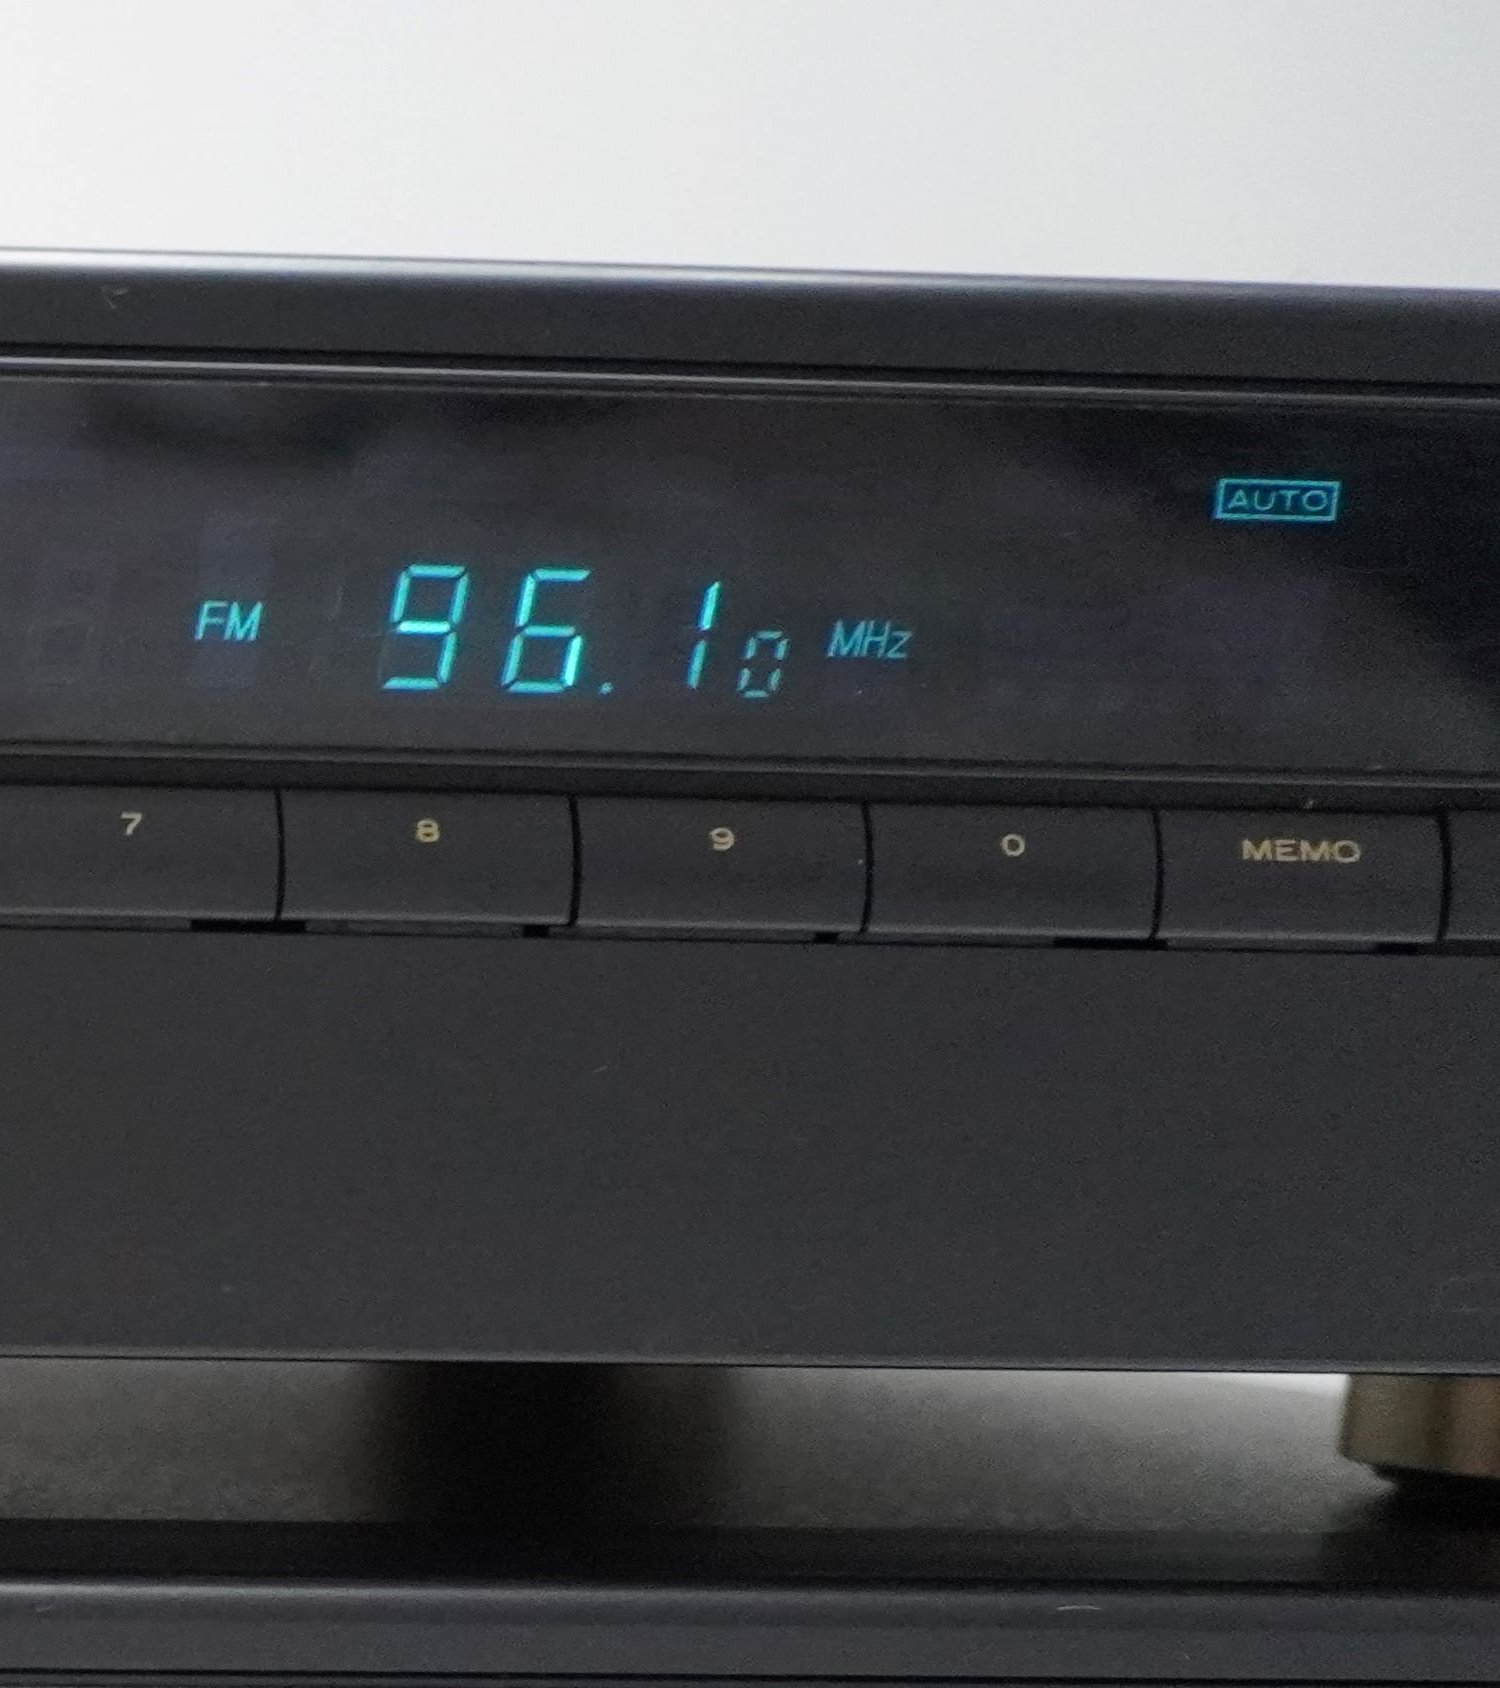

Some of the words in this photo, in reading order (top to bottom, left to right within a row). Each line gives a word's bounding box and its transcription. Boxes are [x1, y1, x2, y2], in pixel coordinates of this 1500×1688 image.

[1227, 487, 1328, 514] AUTO
[194, 601, 263, 642] FM
[826, 620, 912, 659] MHz
[121, 812, 143, 836] 7
[415, 818, 440, 843] 8
[709, 827, 735, 851] 9
[1241, 838, 1362, 864] MEMO
